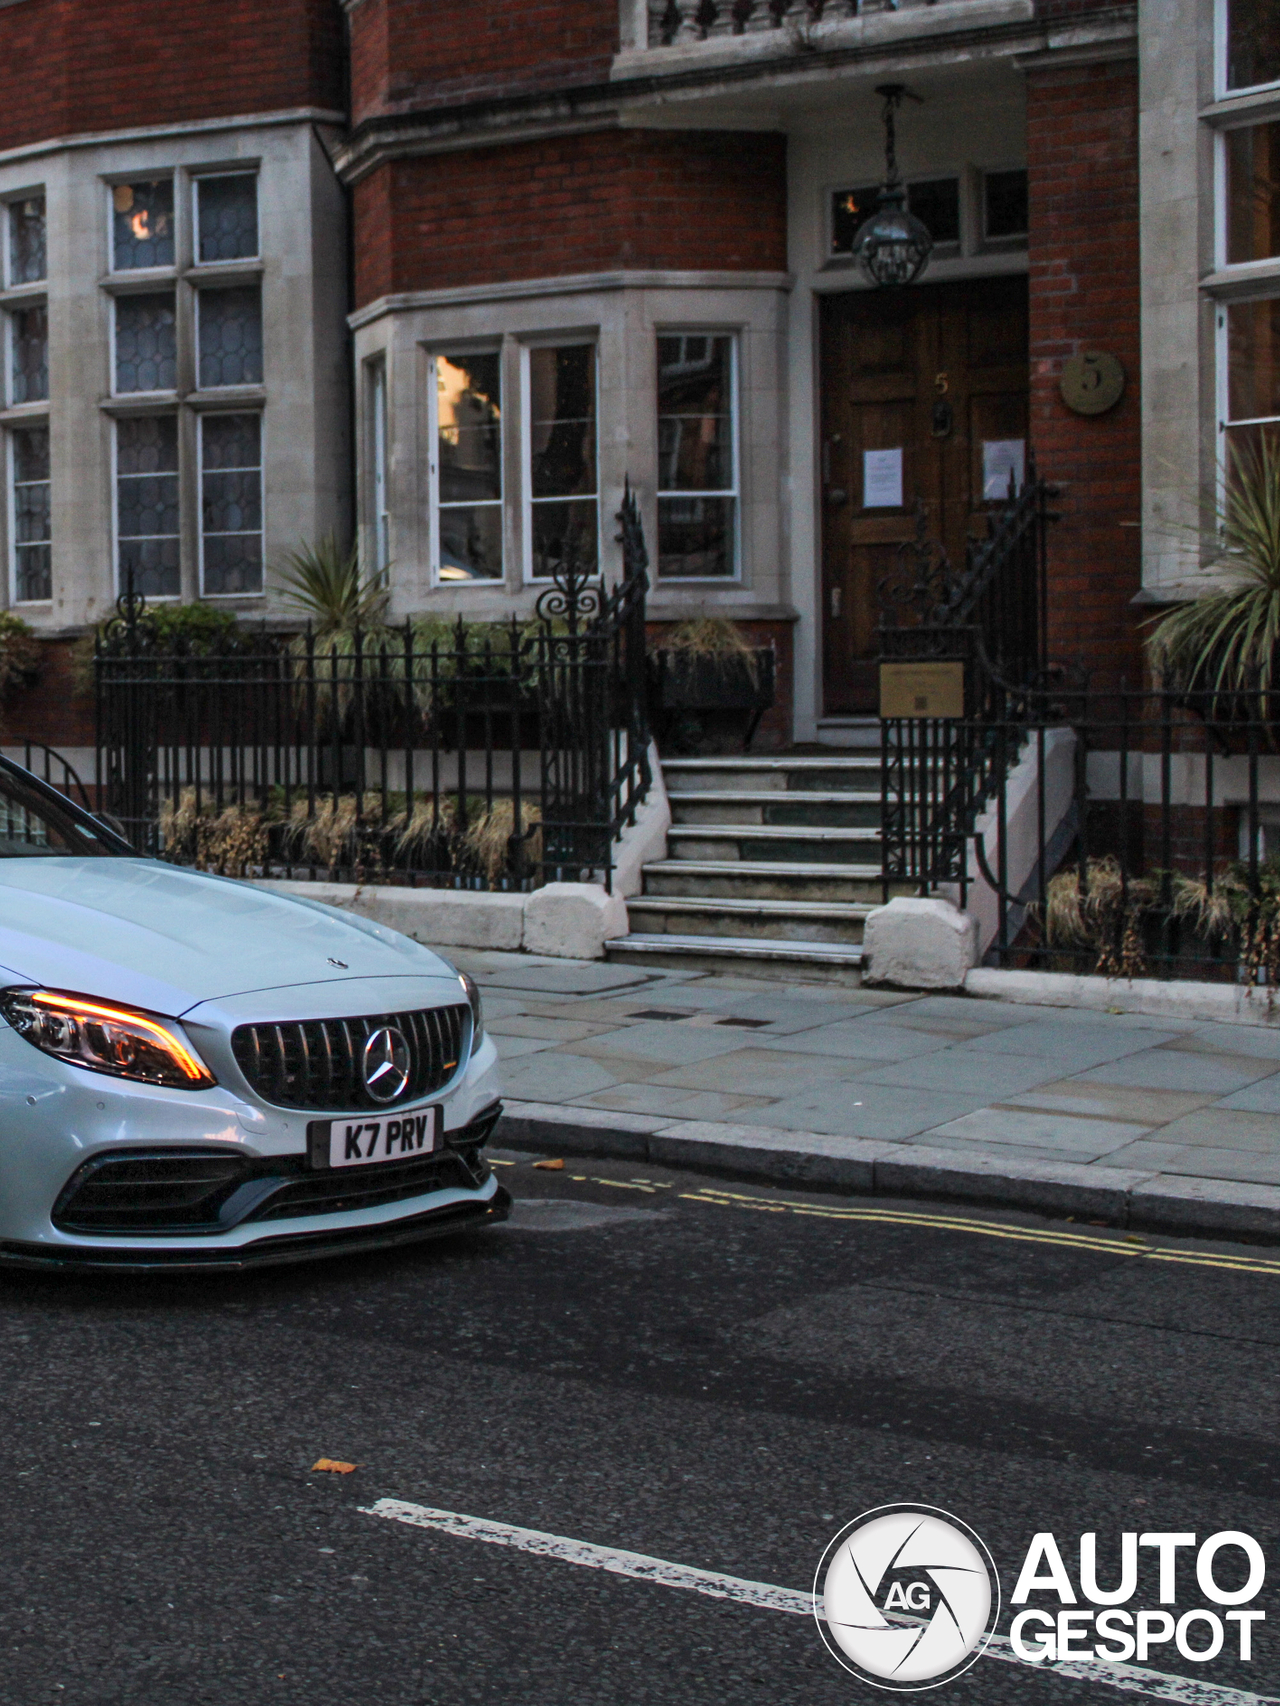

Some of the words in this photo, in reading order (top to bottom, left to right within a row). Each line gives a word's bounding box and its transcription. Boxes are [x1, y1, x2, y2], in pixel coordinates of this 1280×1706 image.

[935, 372, 949, 394] 5
[1078, 353, 1102, 391] 5
[344, 1123, 380, 1160] K7
[385, 1115, 428, 1155] PRV
